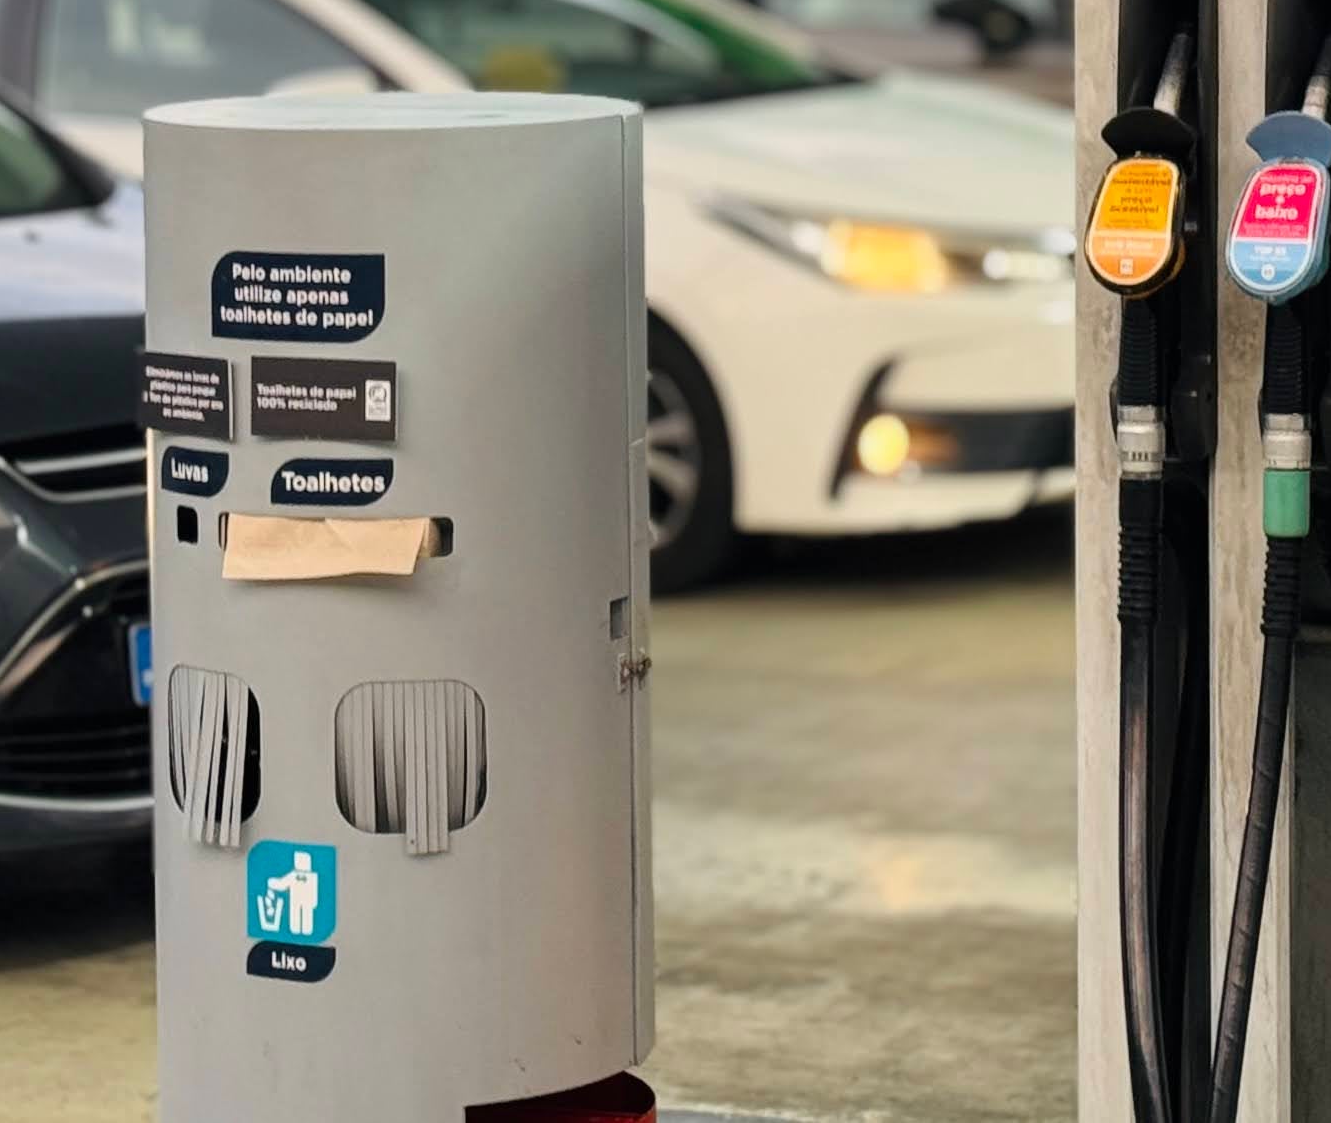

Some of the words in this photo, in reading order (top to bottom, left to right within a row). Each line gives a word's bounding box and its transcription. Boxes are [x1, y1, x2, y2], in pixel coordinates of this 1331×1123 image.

[1259, 183, 1307, 198] preço
[1255, 204, 1299, 220] baixo
[232, 262, 266, 281] Pelo
[269, 265, 352, 284] ambiente
[234, 285, 282, 303] utilize
[286, 289, 349, 306] apenas
[220, 306, 291, 325] toalhetes
[295, 308, 318, 326] de
[322, 309, 374, 330] papel
[256, 383, 308, 397] Toalhetes
[309, 385, 324, 398] de
[325, 386, 357, 400] papel
[256, 396, 286, 409] 100%
[288, 398, 338, 411] reciclado
[171, 457, 209, 483] Luvas
[281, 471, 386, 493] Toalhetes
[271, 951, 307, 972] Lixo
